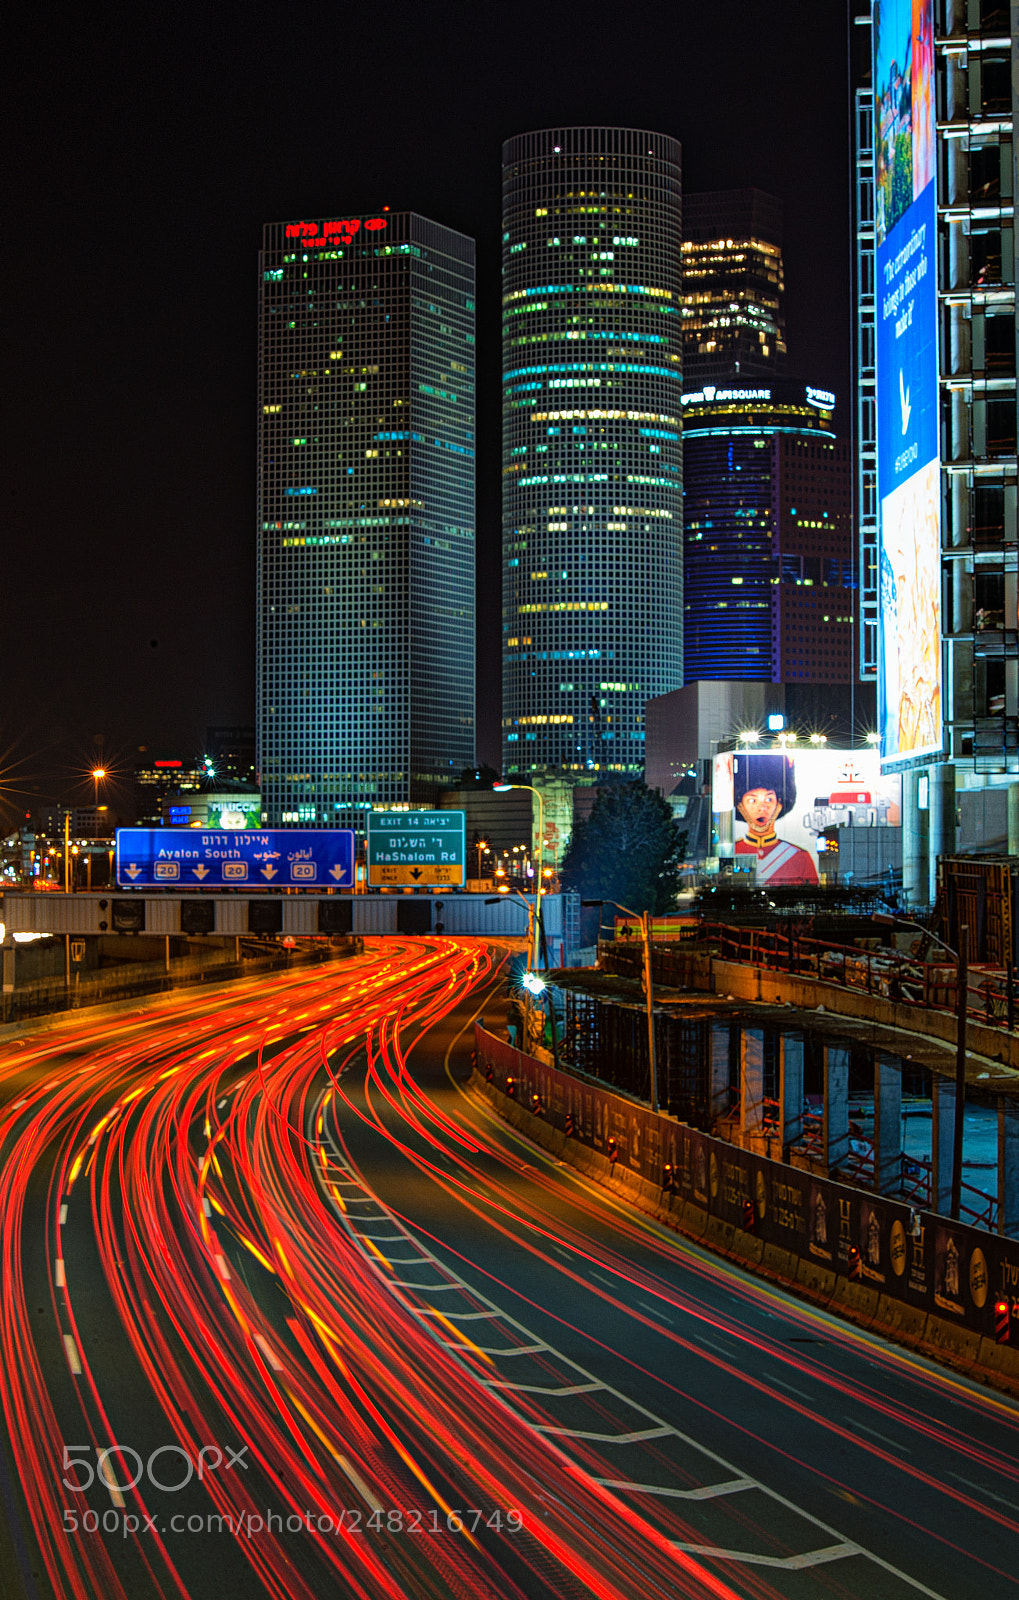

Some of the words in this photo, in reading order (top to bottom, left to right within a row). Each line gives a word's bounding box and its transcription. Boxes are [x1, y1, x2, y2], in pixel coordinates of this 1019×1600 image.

[380, 817, 402, 826] EXIT
[408, 817, 419, 826] 14
[423, 817, 450, 826] יציאה
[202, 835, 228, 846] דרום
[234, 835, 269, 847] איילון
[389, 837, 426, 848] השלום
[158, 848, 200, 860] Ayalon
[204, 848, 241, 859] South
[375, 851, 436, 862] HaShalom
[441, 851, 456, 862] Rd
[160, 867, 174, 875] 20
[228, 867, 242, 875] 20
[296, 867, 311, 875] 20
